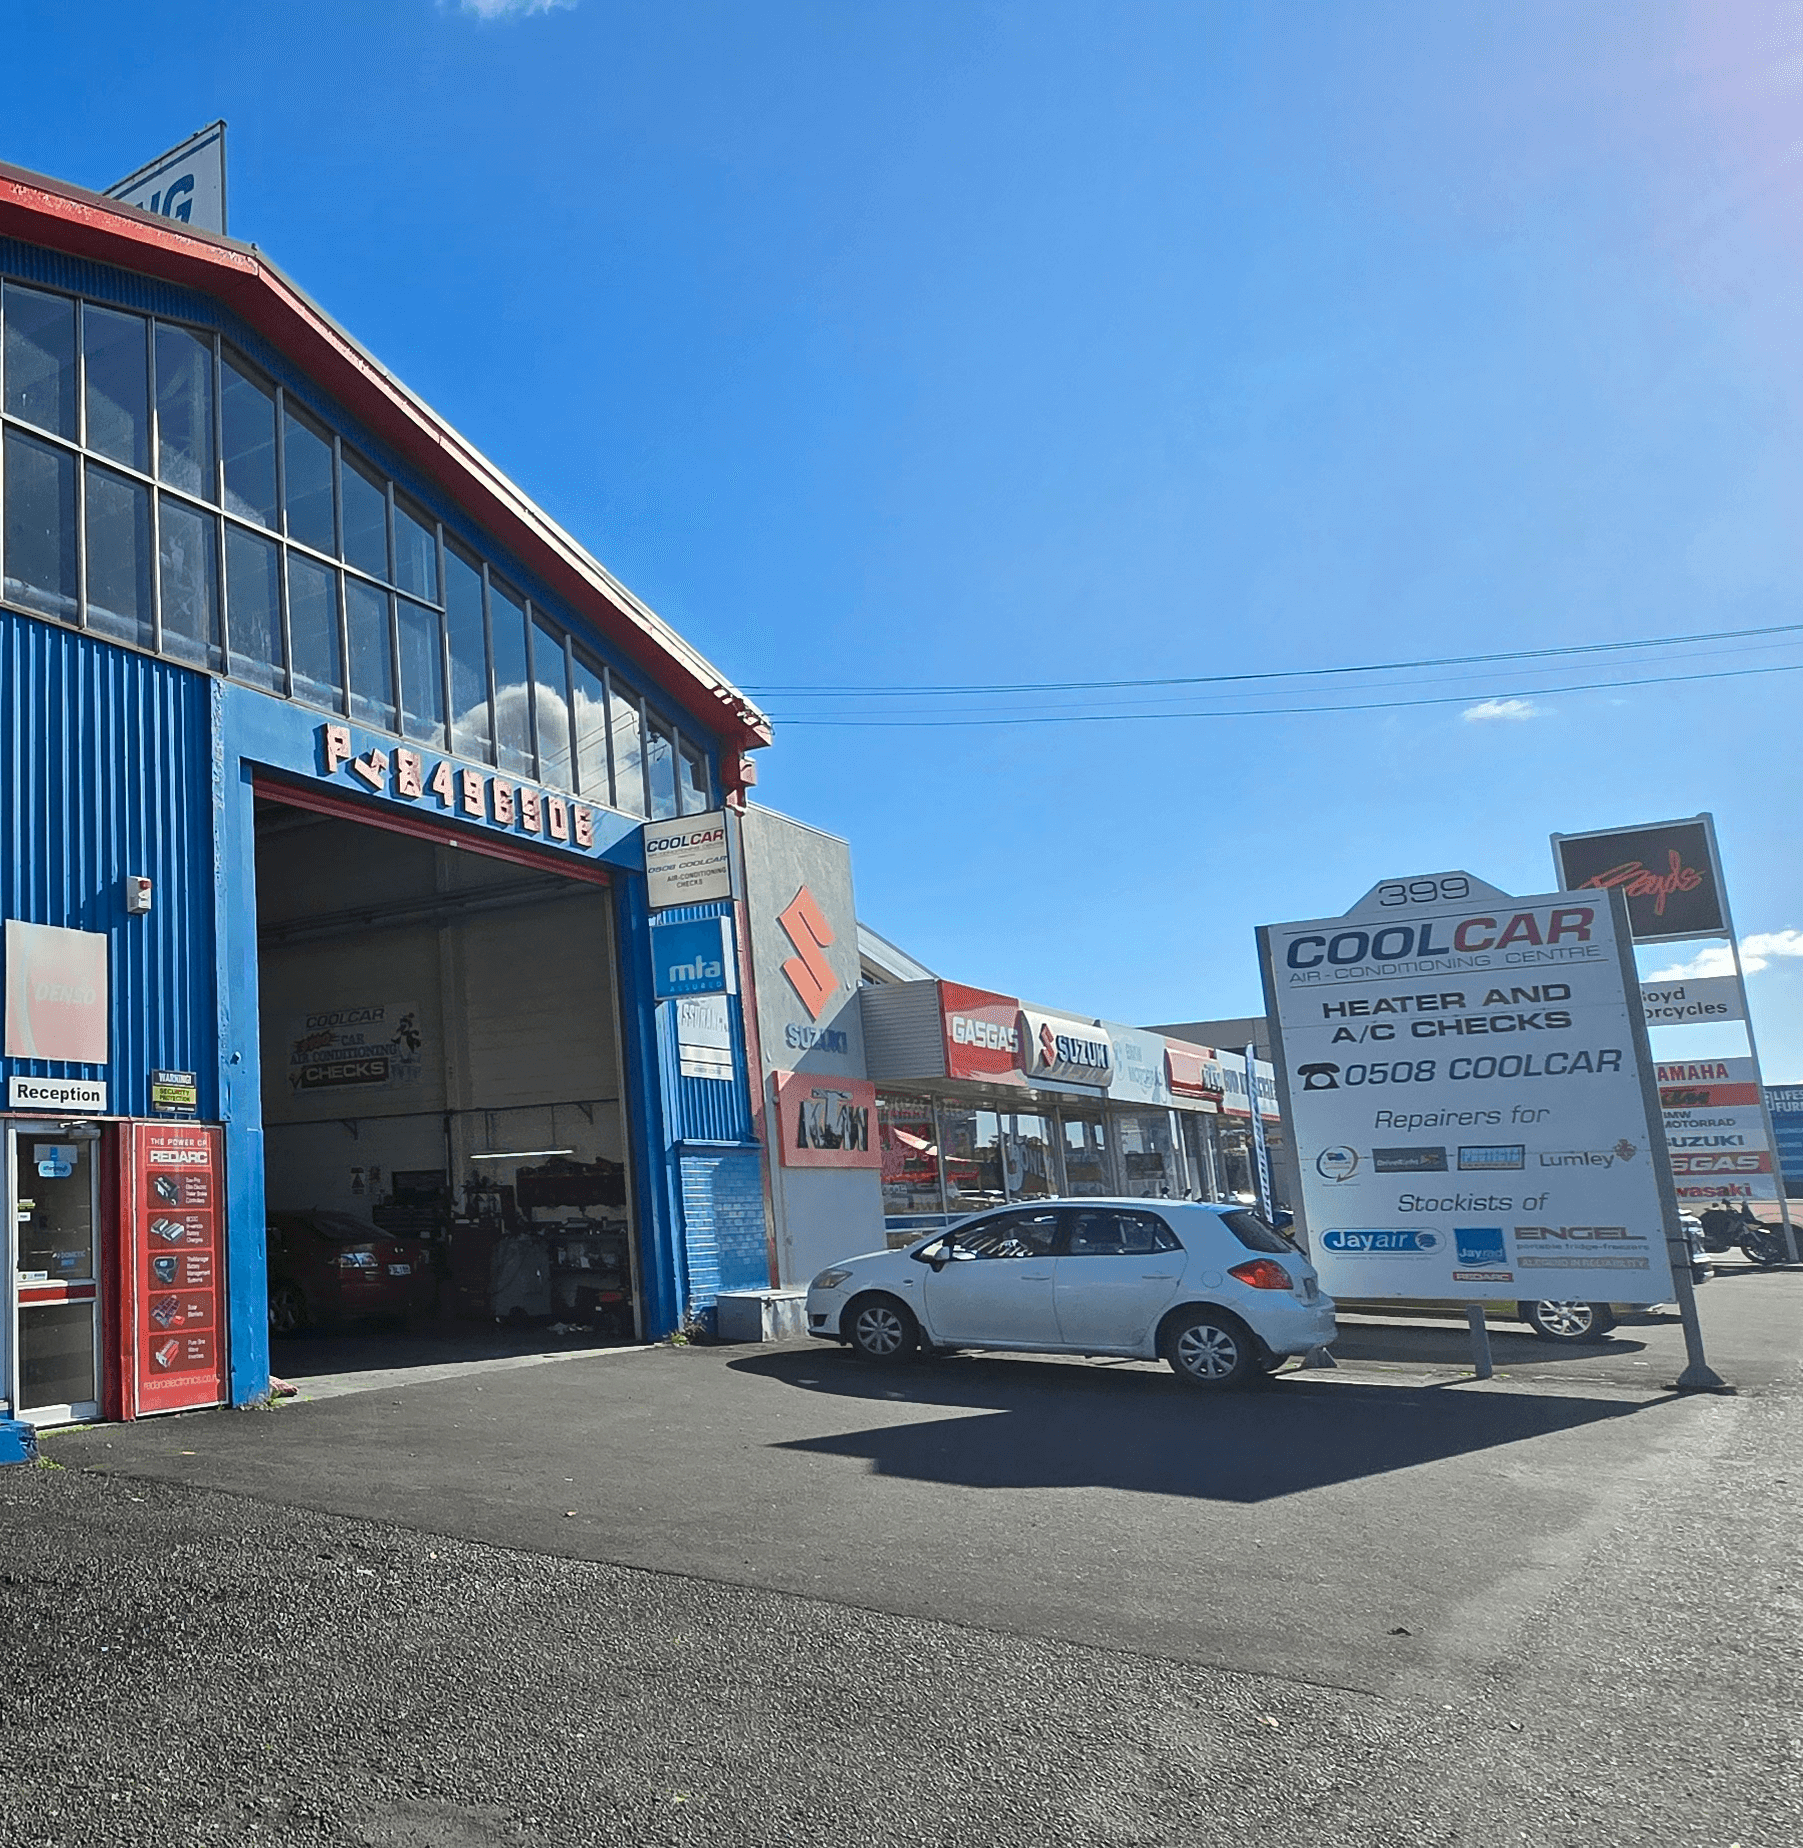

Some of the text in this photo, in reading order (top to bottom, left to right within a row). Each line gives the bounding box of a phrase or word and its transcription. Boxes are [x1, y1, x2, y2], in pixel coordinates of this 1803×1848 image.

[646, 828, 724, 854] COOLCAR
[647, 855, 728, 875] 0508 COOLCAR
[666, 866, 727, 882] AIR-CONDITIONING
[676, 878, 703, 889] CHECKS
[1378, 876, 1471, 907] 399
[1286, 906, 1595, 969] COOLCAR
[1504, 944, 1600, 966] CENTRE
[669, 954, 722, 983] mta
[1322, 982, 1572, 1019] HEATER AND
[1641, 986, 1687, 1005] oyd
[306, 1007, 385, 1029] COOLCAR
[1330, 1009, 1573, 1044] A/C CHECKS
[341, 1033, 365, 1046] CAR
[785, 1022, 849, 1055] SUZUKI
[952, 1015, 1020, 1054] GASGAS
[312, 1043, 398, 1062] CONDITIONING
[305, 1061, 386, 1082] CHECKS
[1344, 1048, 1623, 1087] 0508 COOLCAR
[1657, 1062, 1730, 1082] AMAHA
[17, 1083, 101, 1103] Reception
[1374, 1105, 1551, 1133] Repairers for
[150, 1137, 165, 1146] THE
[167, 1138, 195, 1146] POWER
[150, 1150, 208, 1164] REDARC
[1539, 1152, 1615, 1169] Lumley
[1398, 1192, 1551, 1213] Stockists of
[1332, 1229, 1408, 1252] Jayair
[1514, 1226, 1648, 1240] ENGEL
[1516, 1243, 1563, 1251] portable
[1456, 1272, 1510, 1282] REDARC
